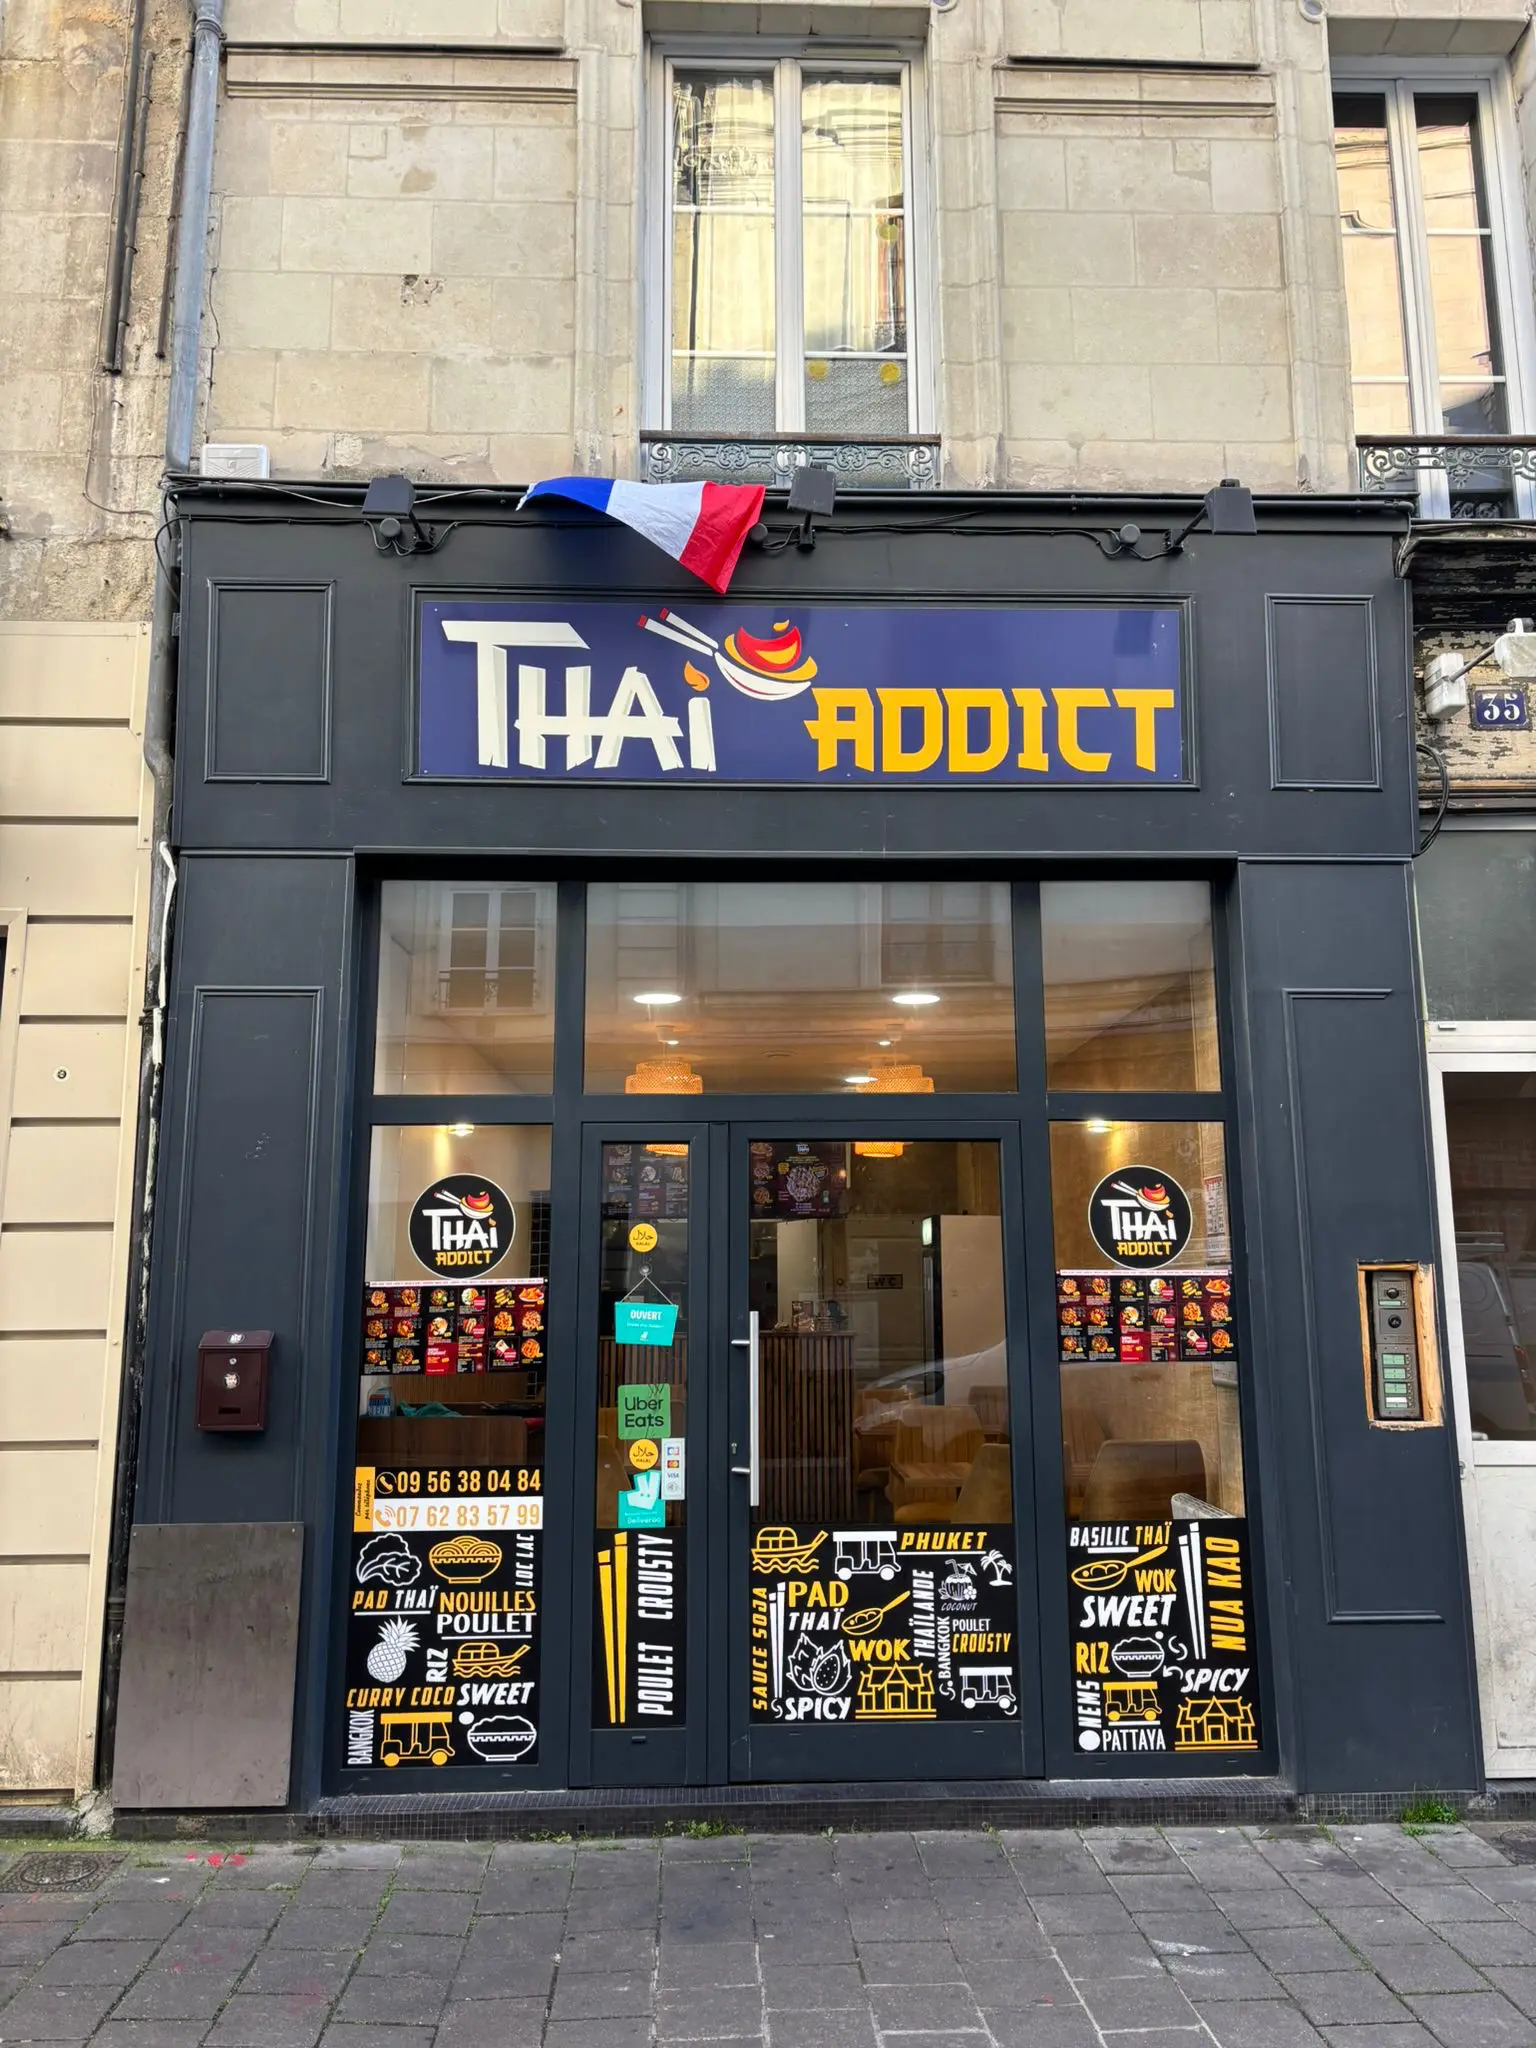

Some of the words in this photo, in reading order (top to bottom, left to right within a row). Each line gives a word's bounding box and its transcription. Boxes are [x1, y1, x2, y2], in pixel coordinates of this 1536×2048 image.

[1482, 692, 1521, 721] 35
[805, 687, 1175, 772] ADDICT
[436, 1250, 493, 1266] ADDICT
[1117, 1241, 1172, 1257] ADDICT
[630, 1308, 663, 1321] OUVERT
[624, 1396, 664, 1411] Uber
[624, 1413, 664, 1428] Eats
[397, 1470, 421, 1493] 09
[427, 1470, 450, 1493] 56
[457, 1469, 481, 1492] 38
[487, 1469, 511, 1492] 04
[517, 1468, 541, 1492] 84
[396, 1505, 420, 1528] 07
[426, 1505, 449, 1527] 62
[456, 1504, 480, 1527] 83
[487, 1503, 510, 1526] 57
[516, 1503, 540, 1526] 99
[515, 1533, 535, 1557] LAC
[900, 1531, 988, 1550] PHUKET
[1070, 1526, 1129, 1547] BASILIC
[1135, 1521, 1173, 1546] THAÏ
[515, 1559, 534, 1587] LOC
[1205, 1536, 1242, 1589] KAO
[637, 1533, 674, 1621] CROUSTY
[1135, 1568, 1177, 1593] WOK
[352, 1590, 388, 1610] PAD
[394, 1584, 439, 1609] THAÏ
[439, 1590, 536, 1613] NOUILLES
[788, 1580, 849, 1608] PAD
[941, 1602, 978, 1611] COCONUT
[436, 1613, 537, 1634] POULET
[752, 1587, 768, 1639] SOJA
[788, 1607, 845, 1631] THAÏ
[908, 1568, 936, 1658] THAÏLANDE
[1079, 1594, 1177, 1629] SWEET
[952, 1618, 991, 1632] POULET
[1209, 1600, 1247, 1651] NUA
[848, 1638, 911, 1662] WOK
[937, 1616, 951, 1679] BANGKOK
[952, 1633, 1011, 1653] CROUSTY
[426, 1647, 449, 1683] RIZ
[1076, 1641, 1111, 1674] RIZ
[637, 1642, 674, 1716] POULET
[752, 1646, 768, 1710] SAUCE
[1180, 1668, 1250, 1693] SPICY
[346, 1687, 406, 1708] CURRY
[410, 1686, 456, 1706] COCO
[456, 1682, 535, 1706] SWEET
[1076, 1679, 1102, 1728] NEMS
[785, 1697, 852, 1720] SPICY
[347, 1709, 375, 1765] BANGKOK
[1102, 1728, 1166, 1752] PATTAYA
